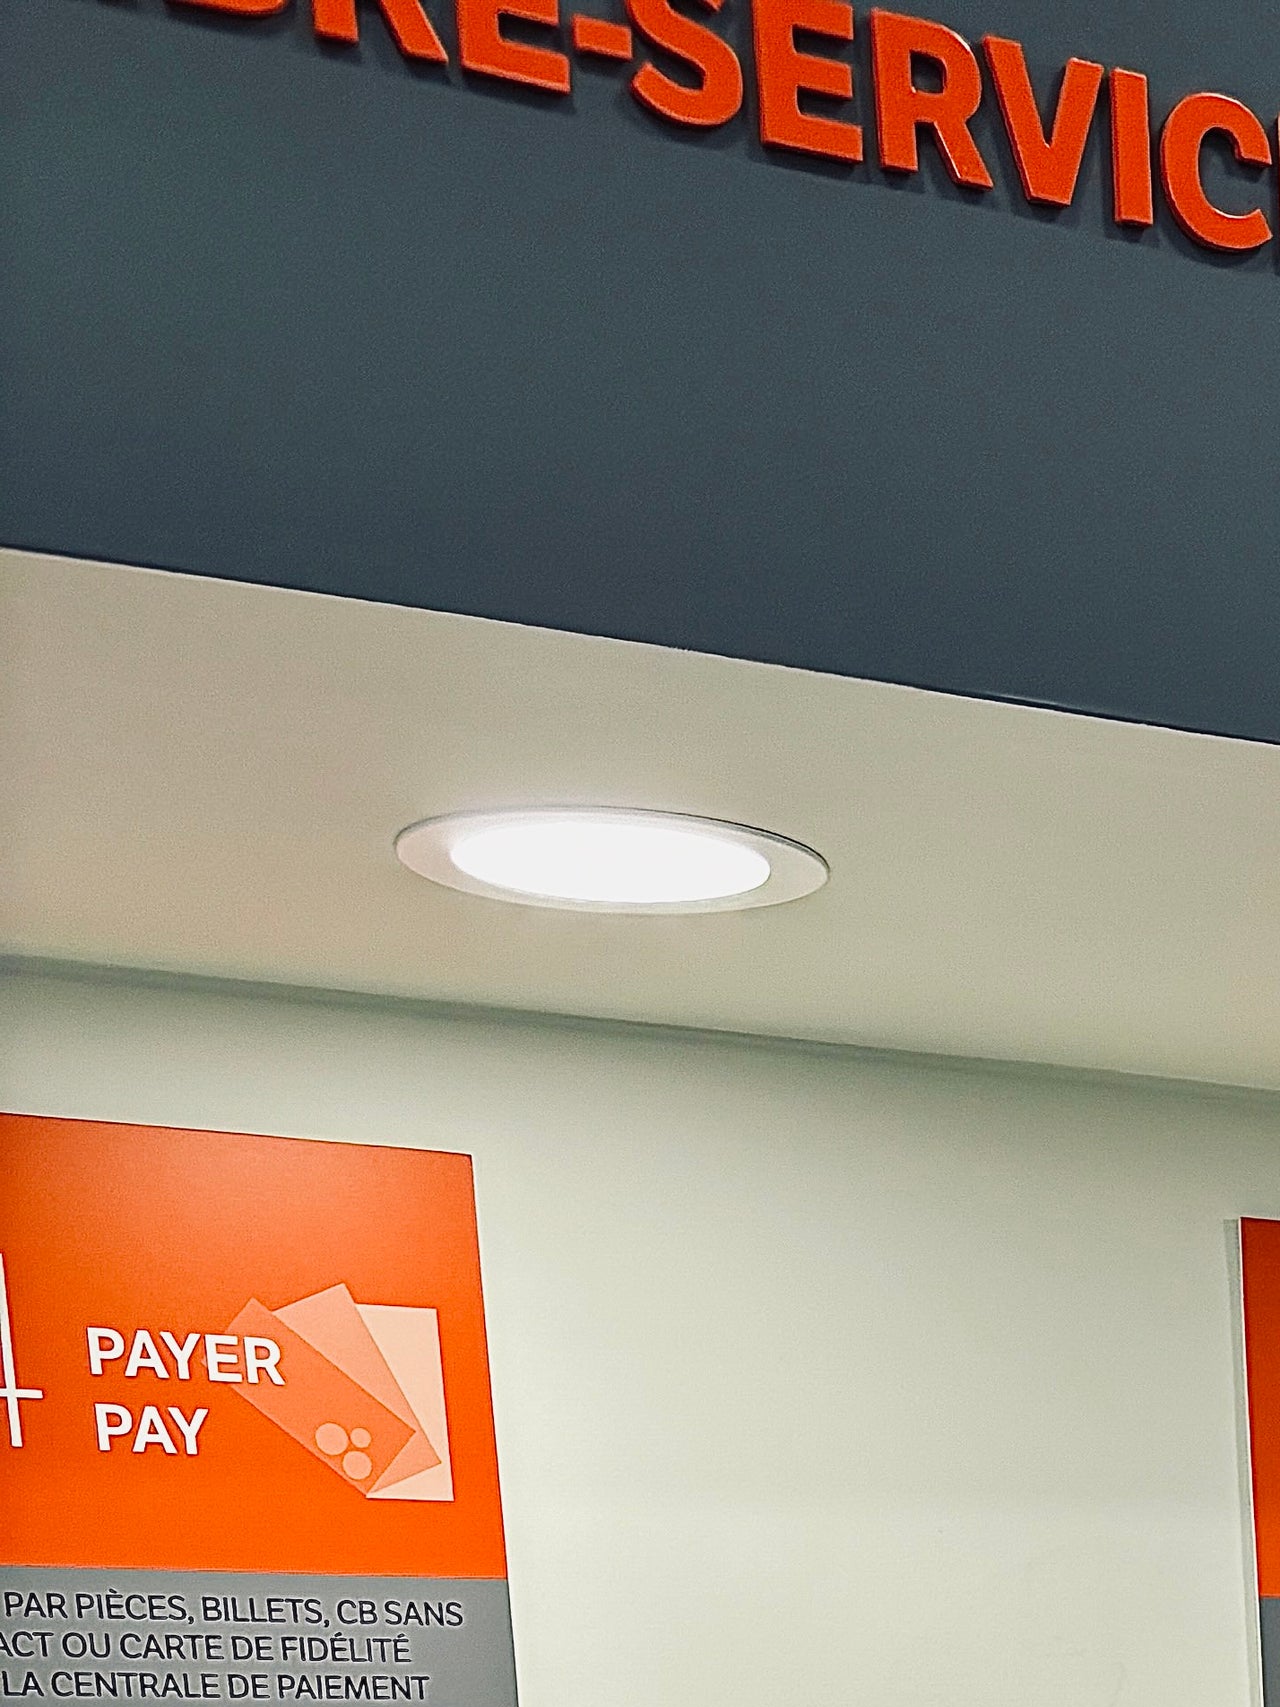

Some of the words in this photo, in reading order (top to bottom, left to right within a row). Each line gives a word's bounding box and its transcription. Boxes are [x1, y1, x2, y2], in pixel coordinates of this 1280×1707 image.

[86, 1326, 286, 1386] PAYER
[93, 1402, 209, 1456] PAY
[4, 1591, 68, 1619] PAR
[75, 1588, 195, 1625] PIÈCES,
[202, 1597, 331, 1629] BILLETS,
[336, 1600, 378, 1626] CB
[385, 1601, 464, 1627] SANS
[62, 1632, 111, 1659] OU
[119, 1633, 225, 1660] CARTE
[231, 1635, 274, 1661] DE
[281, 1633, 412, 1665] FIDÉLITÉ
[2, 1670, 45, 1698] LA
[51, 1671, 221, 1699] CENTRALE
[227, 1673, 271, 1699] DE
[278, 1675, 430, 1701] PAIEMENT
